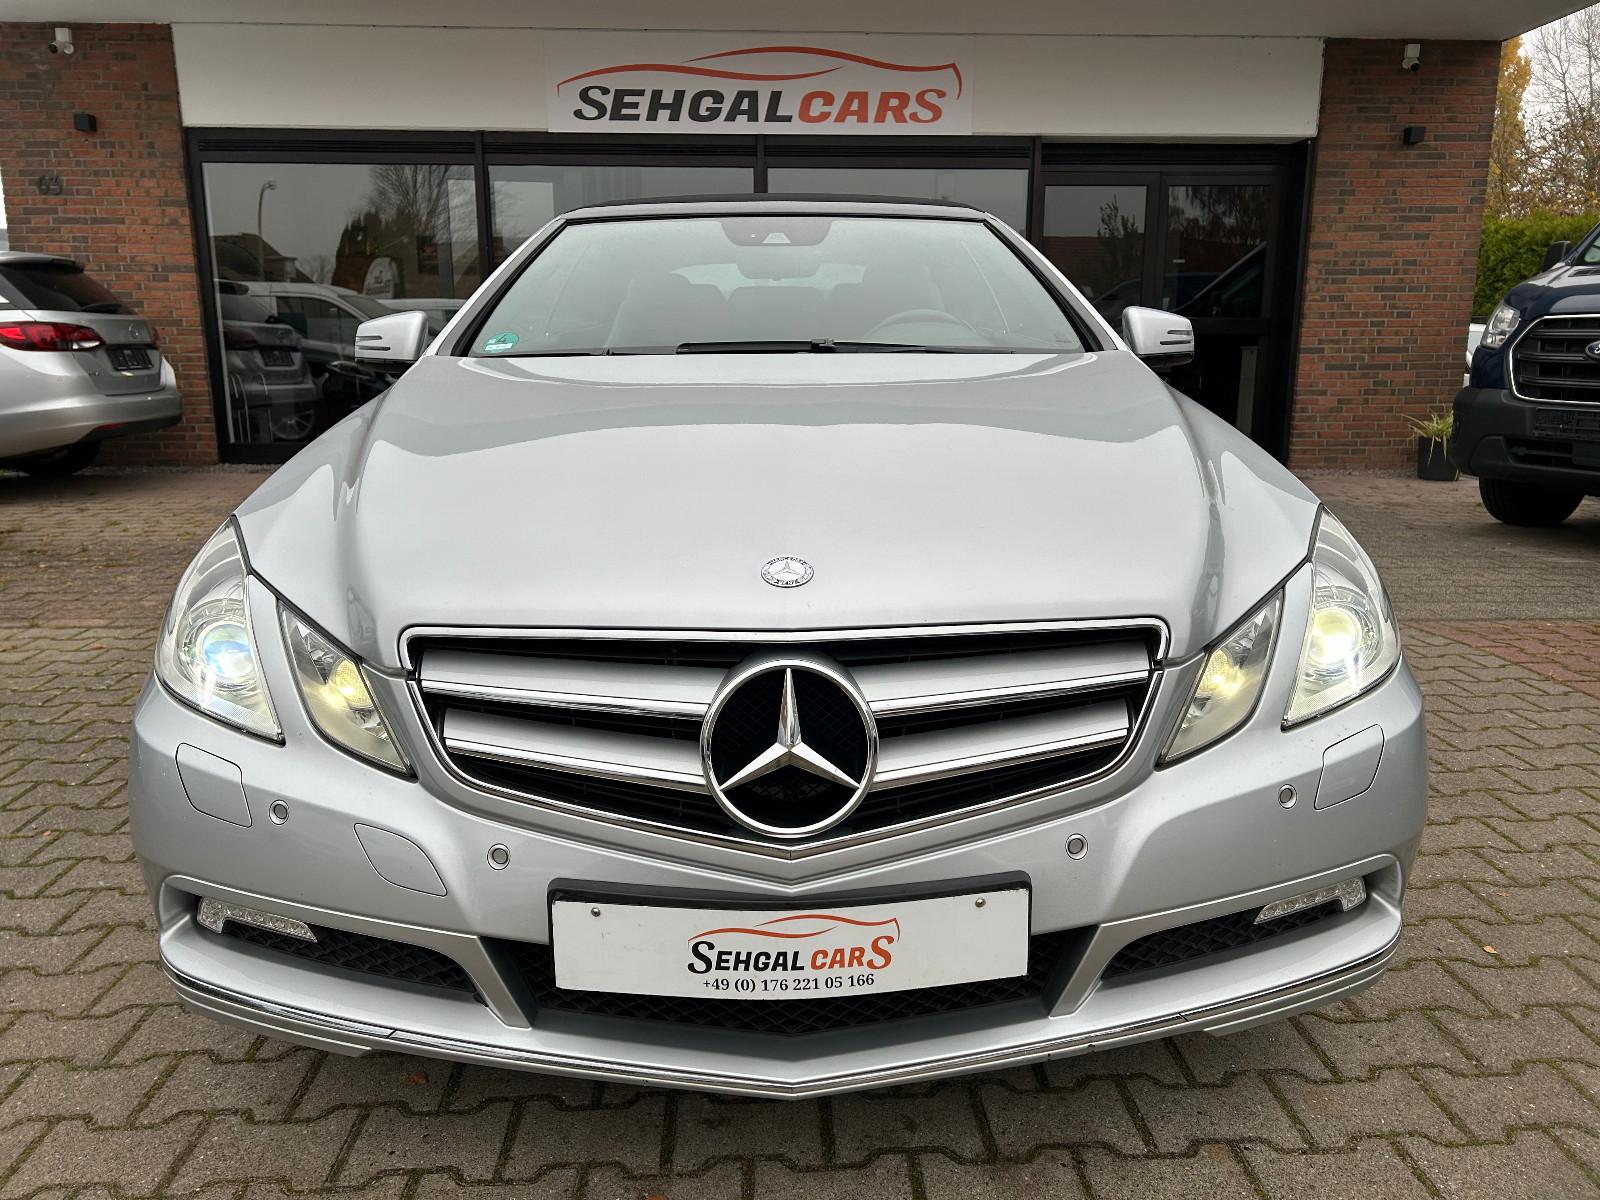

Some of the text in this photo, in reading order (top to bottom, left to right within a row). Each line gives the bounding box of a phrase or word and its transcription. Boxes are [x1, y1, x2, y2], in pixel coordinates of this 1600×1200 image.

[688, 936, 894, 974] SEHGAL CARS
[703, 974, 874, 993] +49 (0) 176 221 05 166
